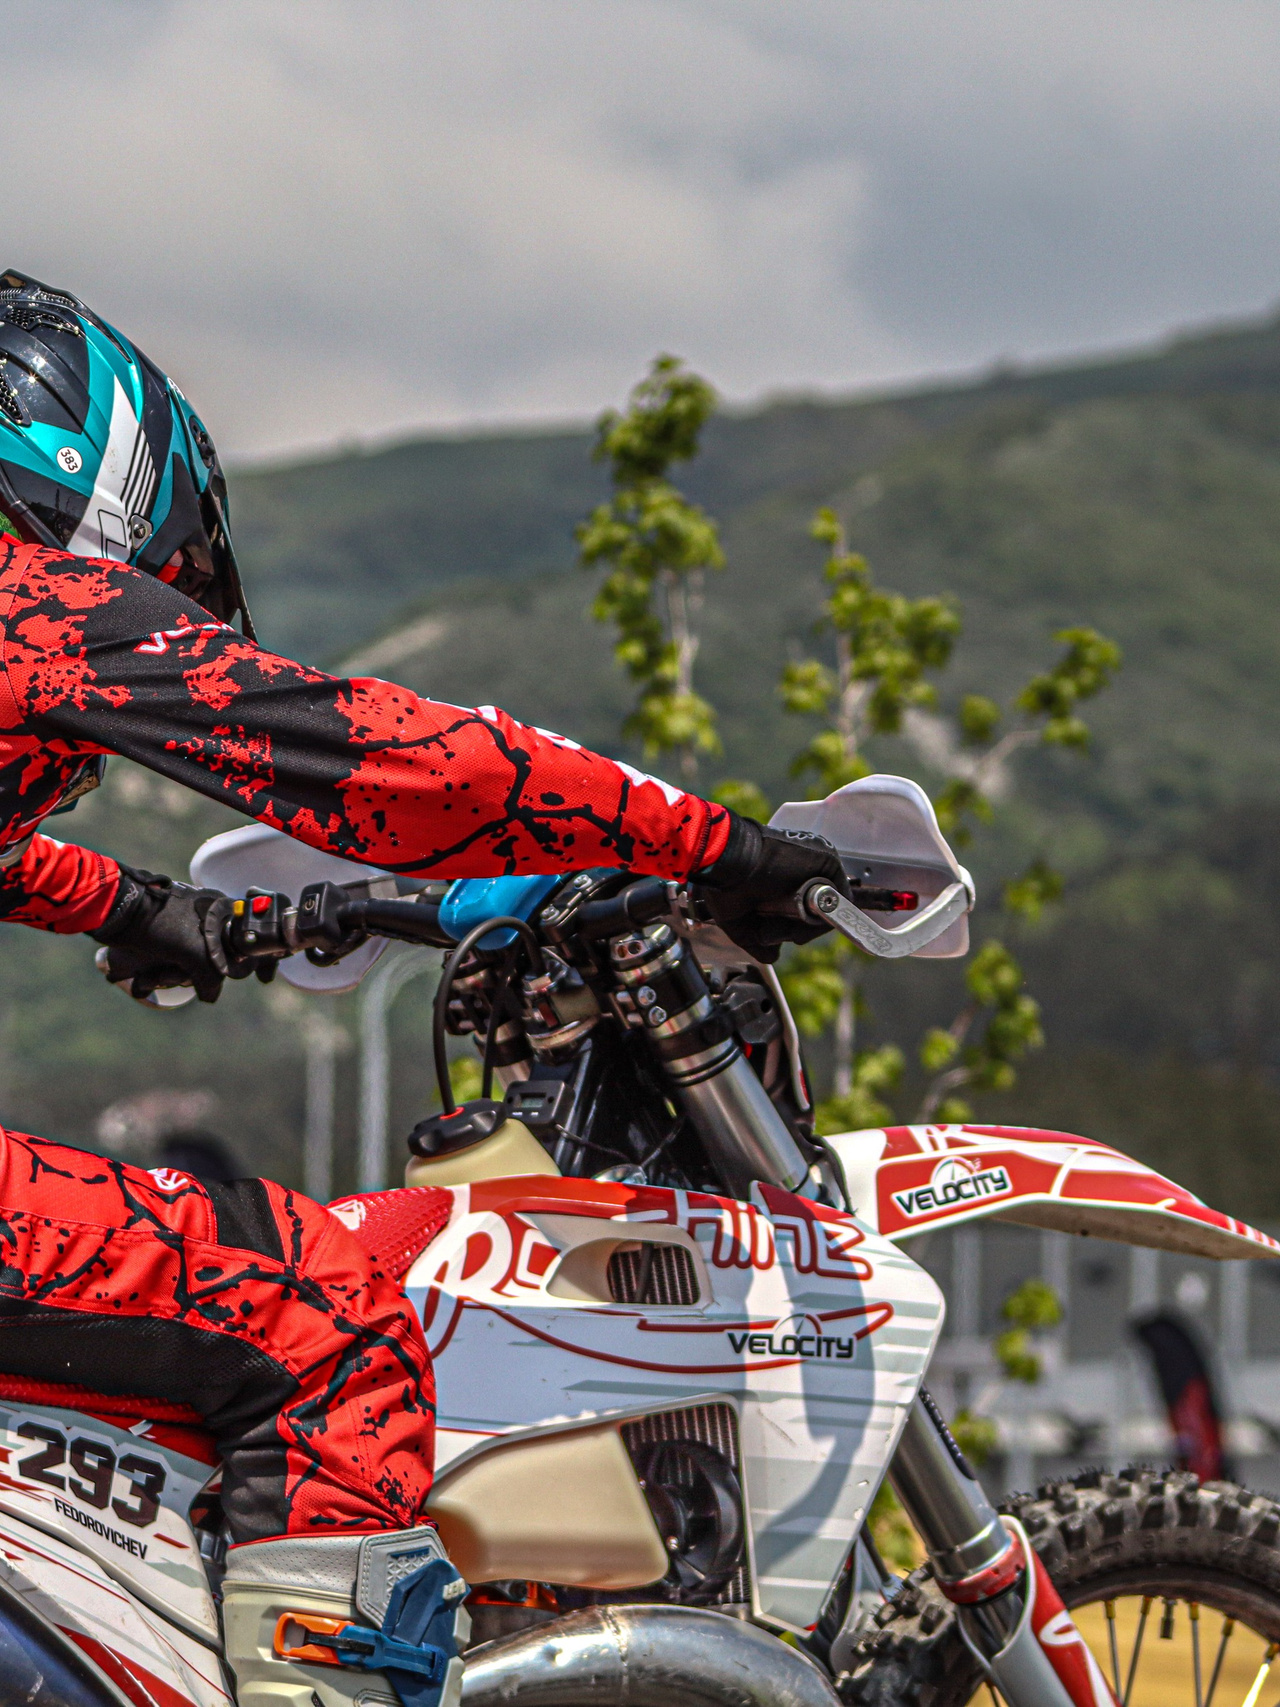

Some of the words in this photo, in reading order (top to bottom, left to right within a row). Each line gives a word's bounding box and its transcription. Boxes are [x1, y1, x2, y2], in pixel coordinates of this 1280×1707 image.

[60, 449, 79, 471] 383
[895, 1169, 1009, 1215] VELOCITY
[727, 1331, 854, 1359] VELOCITY
[17, 1420, 167, 1529] 293
[54, 1497, 148, 1560] FEDOROVICHEV
